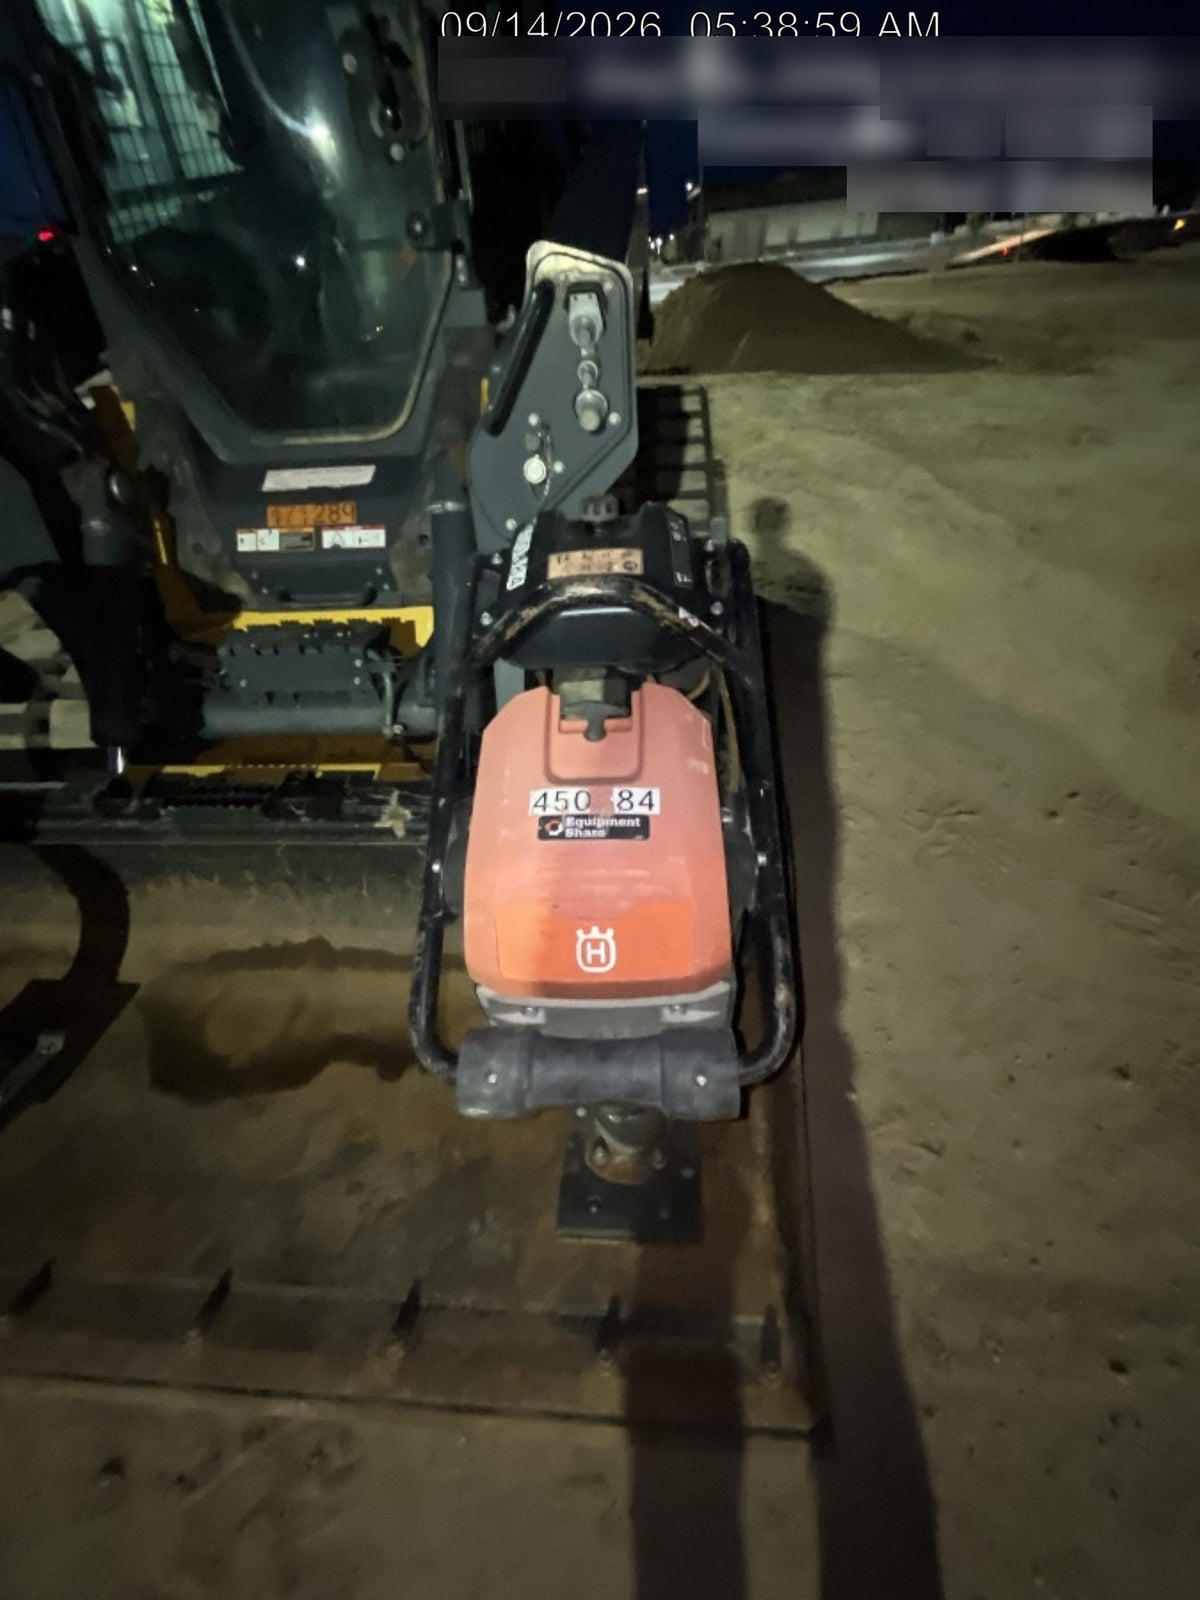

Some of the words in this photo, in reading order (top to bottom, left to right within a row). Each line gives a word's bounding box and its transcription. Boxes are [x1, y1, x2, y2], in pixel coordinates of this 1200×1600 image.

[533, 790, 591, 812] 450
[616, 789, 655, 811] 84
[565, 816, 641, 828] Equipment
[565, 828, 606, 838] Share
